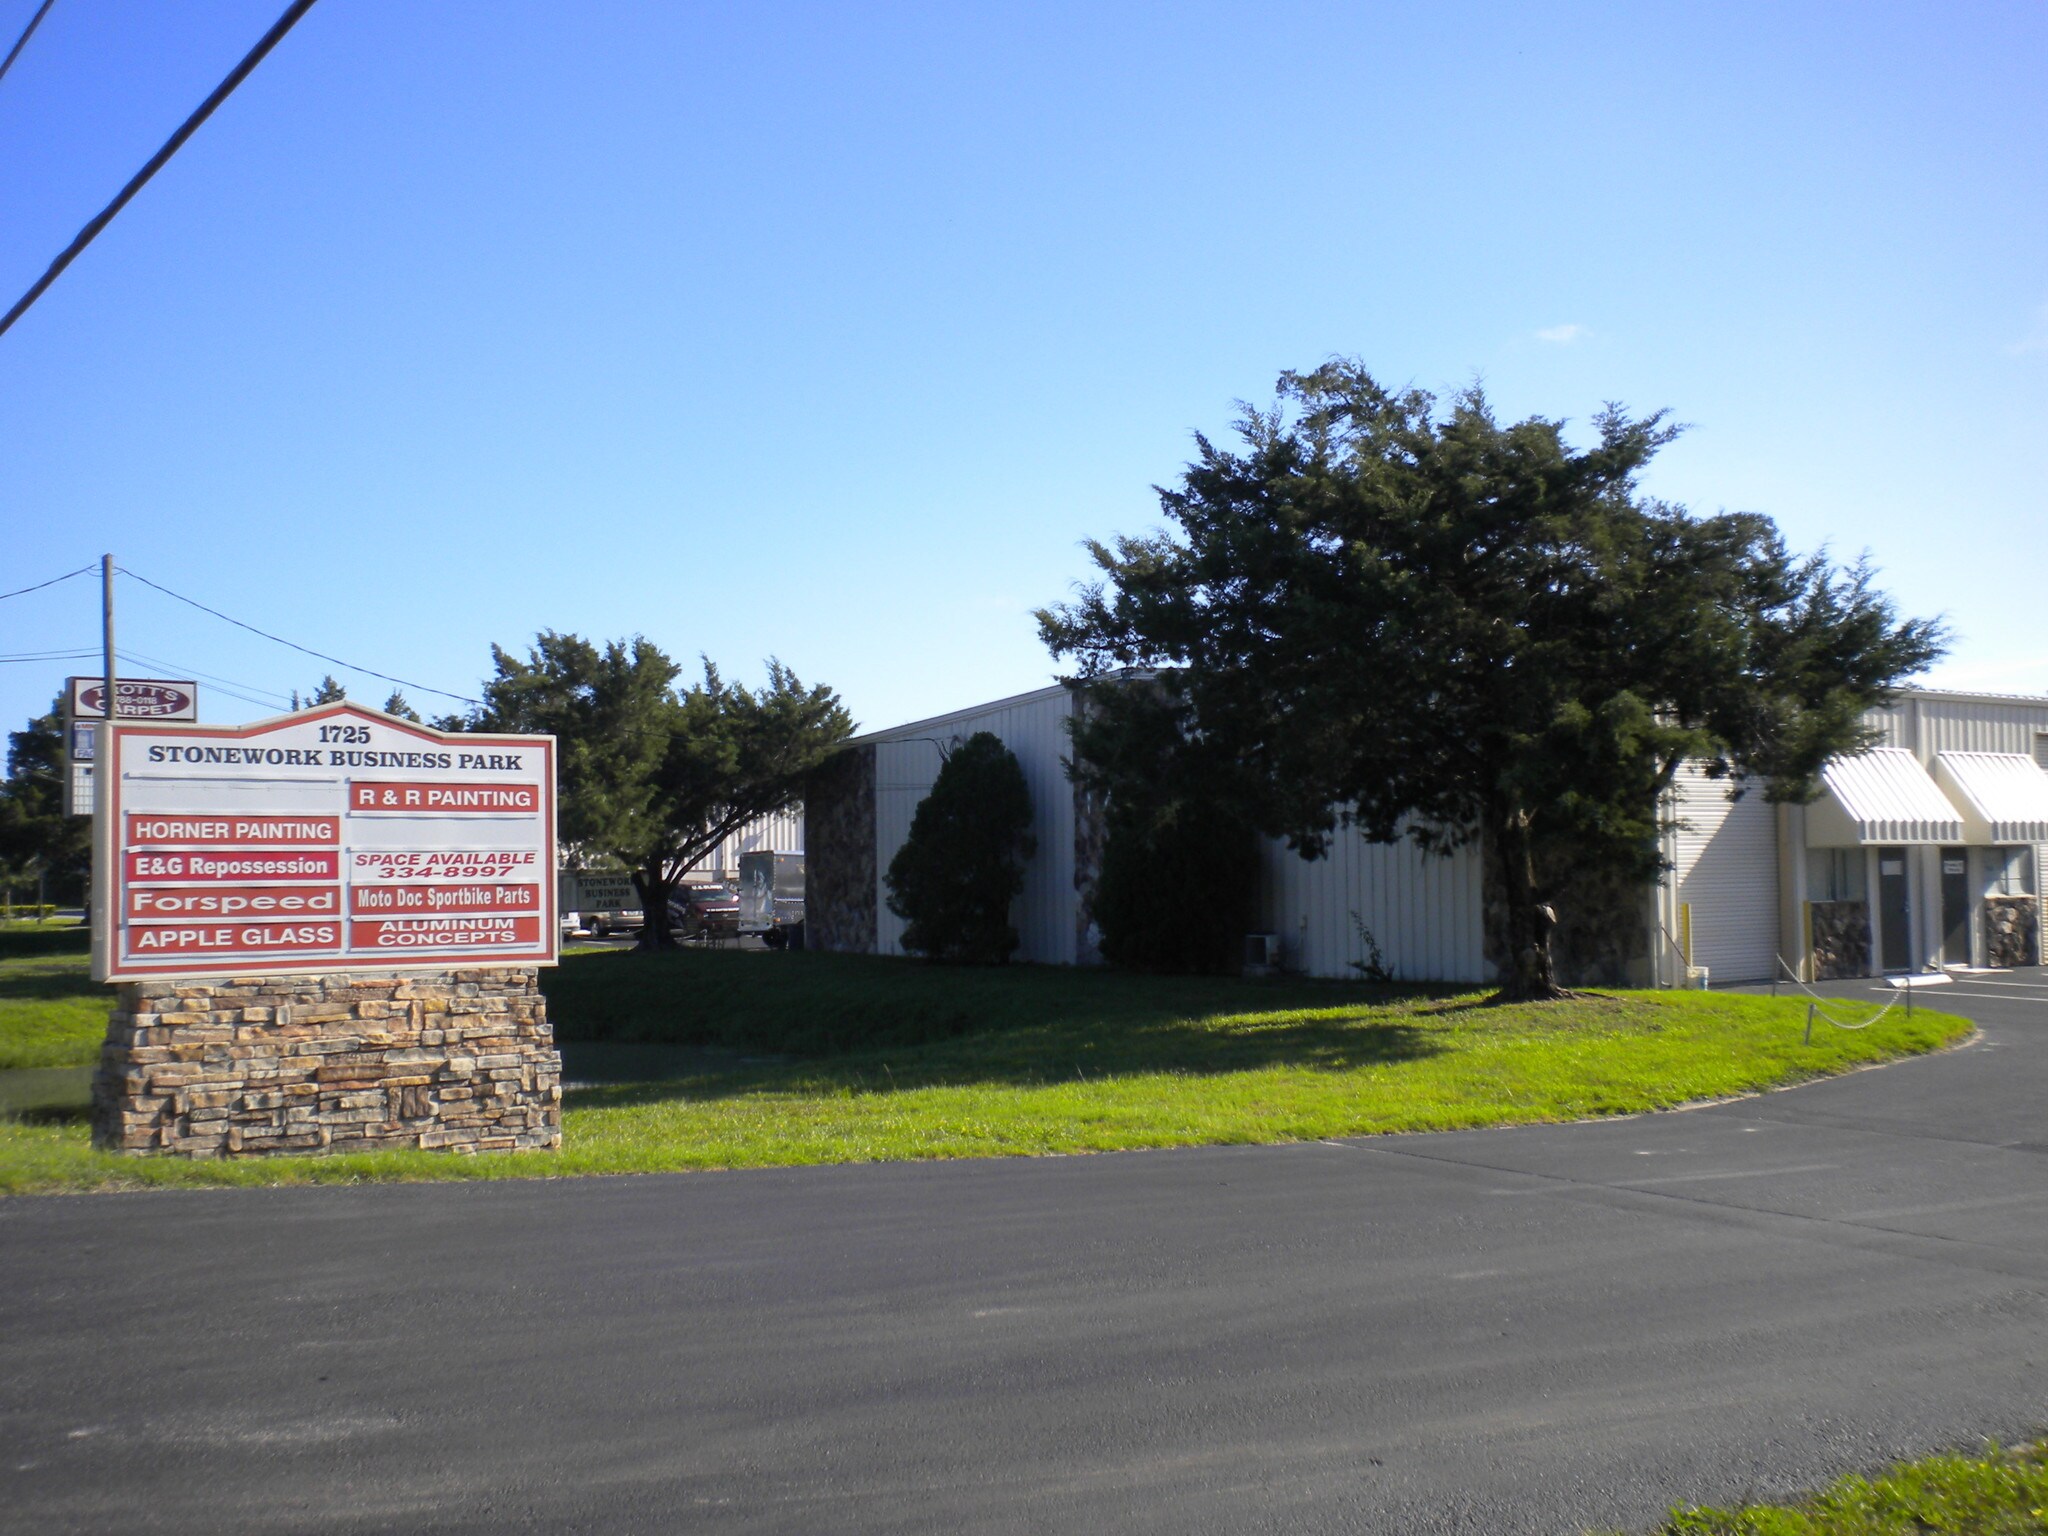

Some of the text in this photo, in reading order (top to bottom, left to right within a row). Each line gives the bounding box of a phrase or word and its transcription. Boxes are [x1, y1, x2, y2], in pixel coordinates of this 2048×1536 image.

[319, 725, 371, 744] 1725
[149, 746, 522, 770] STONEWORK BUSINESS PARK
[359, 789, 531, 807] R & R PAINTING
[136, 822, 332, 839] HORNER PAINTING
[136, 857, 328, 878] E&G Repossession
[355, 853, 536, 866] SPACE AVAILABLE
[378, 866, 514, 879] 334-8997
[358, 886, 530, 910] Moto Doc Sportbike Parts
[585, 888, 630, 898] BUSINESS
[134, 892, 333, 914] Forspeed
[596, 899, 621, 908] PARK
[379, 918, 514, 932] ALUMINUM
[138, 927, 334, 948] APPLE GLASS
[378, 931, 516, 946] CONCEPTS
